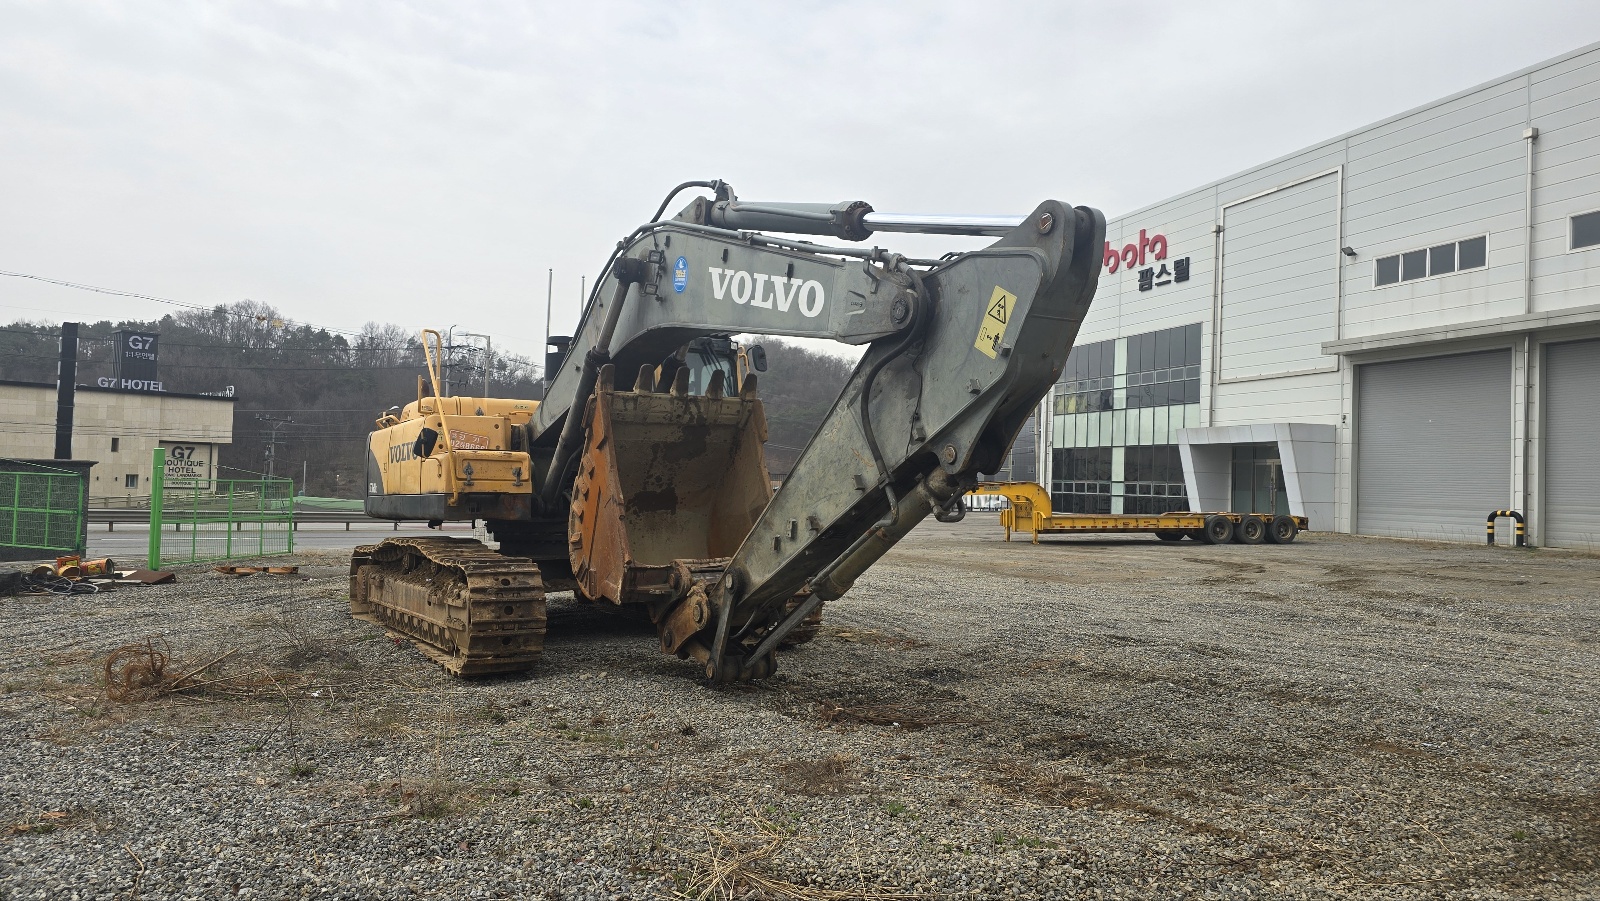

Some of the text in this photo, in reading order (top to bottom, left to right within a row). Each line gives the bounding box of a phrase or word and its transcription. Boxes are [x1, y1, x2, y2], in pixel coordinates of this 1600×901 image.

[1138, 257, 1190, 291] 팜스틸
[709, 267, 824, 317] VOLVO
[129, 336, 153, 350] G7
[98, 377, 166, 392] G7 HOTEL
[171, 446, 195, 459] G7
[168, 466, 196, 474] HOTEL
